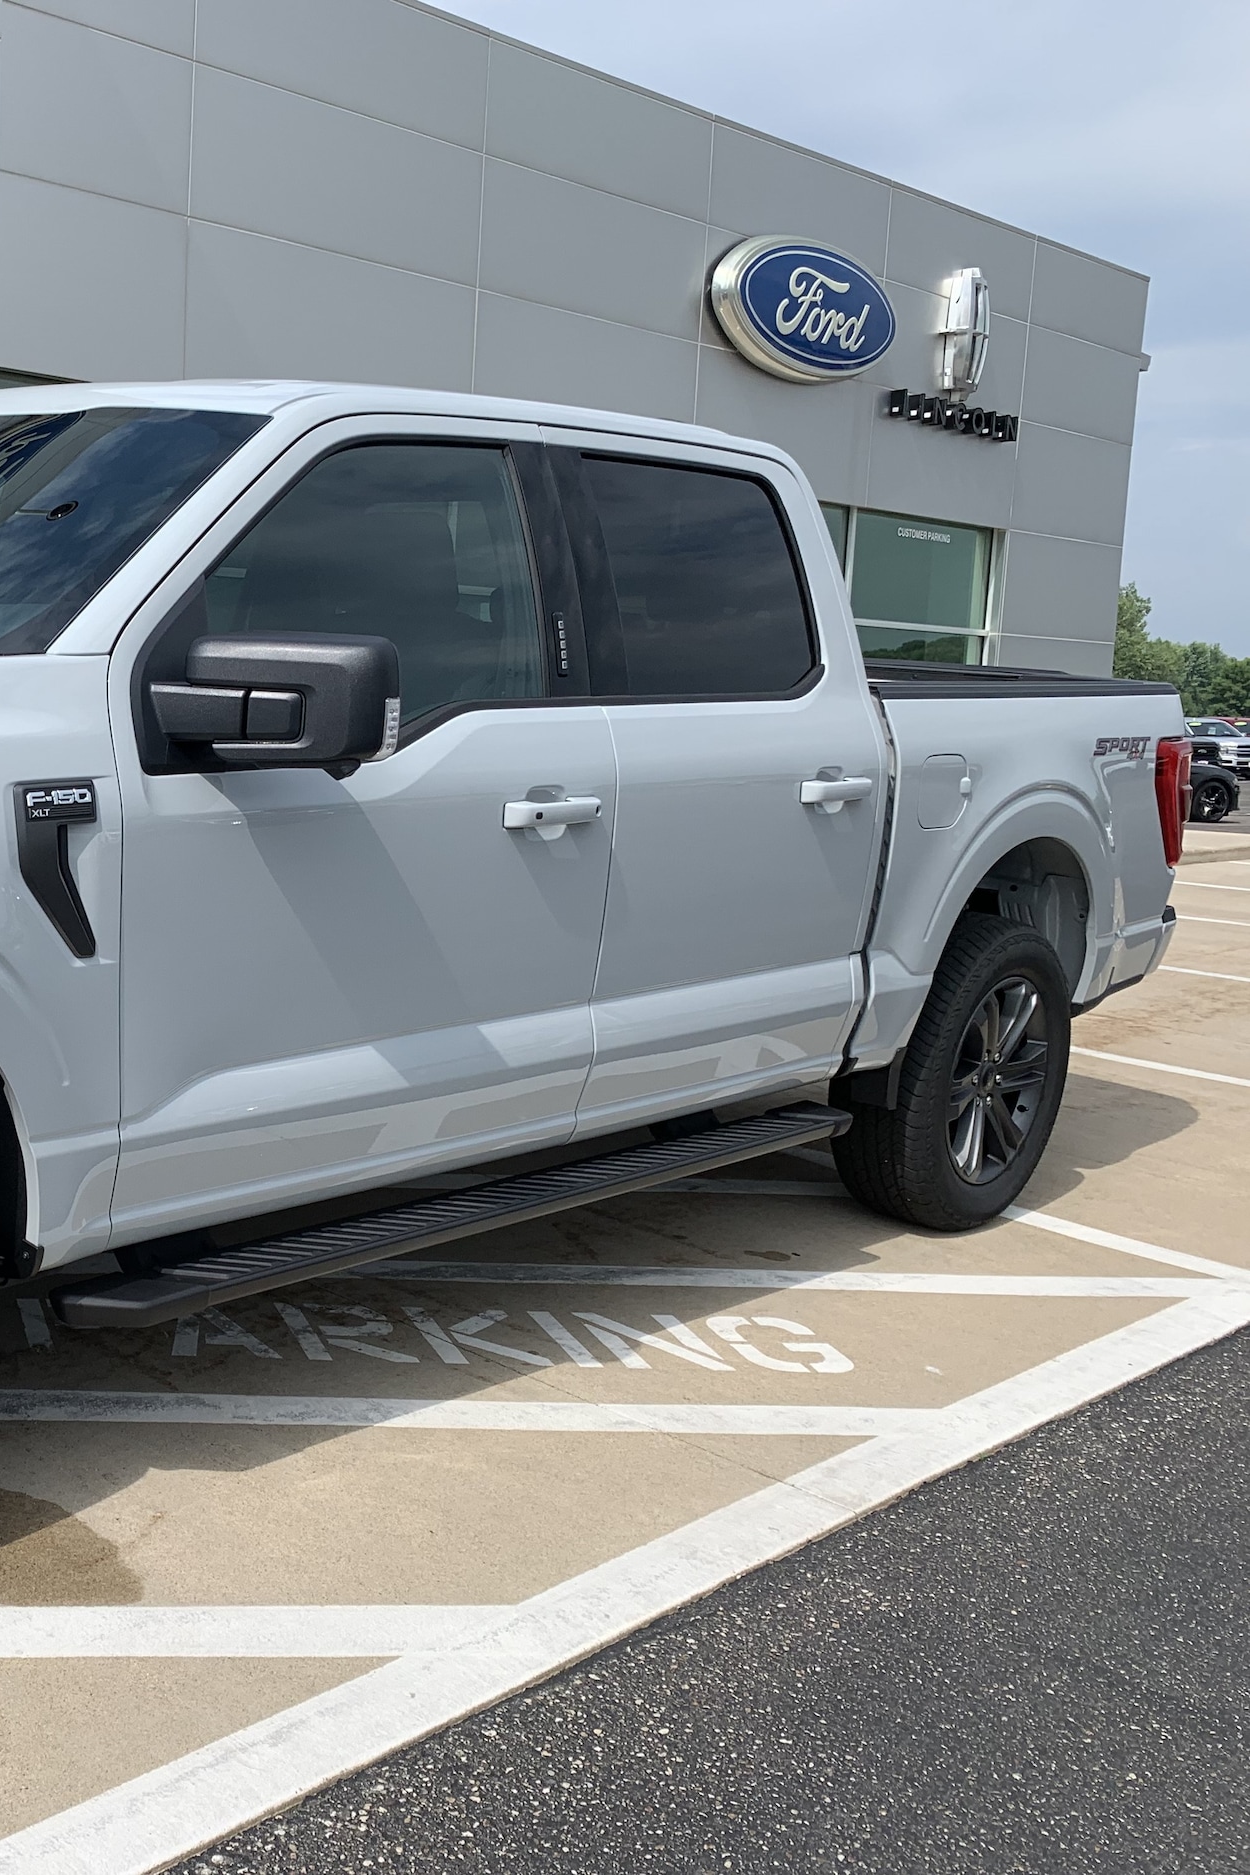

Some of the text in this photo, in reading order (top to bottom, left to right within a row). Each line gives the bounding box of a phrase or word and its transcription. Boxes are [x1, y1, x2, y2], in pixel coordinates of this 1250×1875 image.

[776, 267, 870, 352] Ford
[891, 389, 1018, 441] LINCOLN
[897, 527, 951, 544] CUSTOMER PARKING
[1093, 737, 1151, 756] SPORT
[26, 788, 92, 807] F-150
[31, 809, 50, 818] XLT
